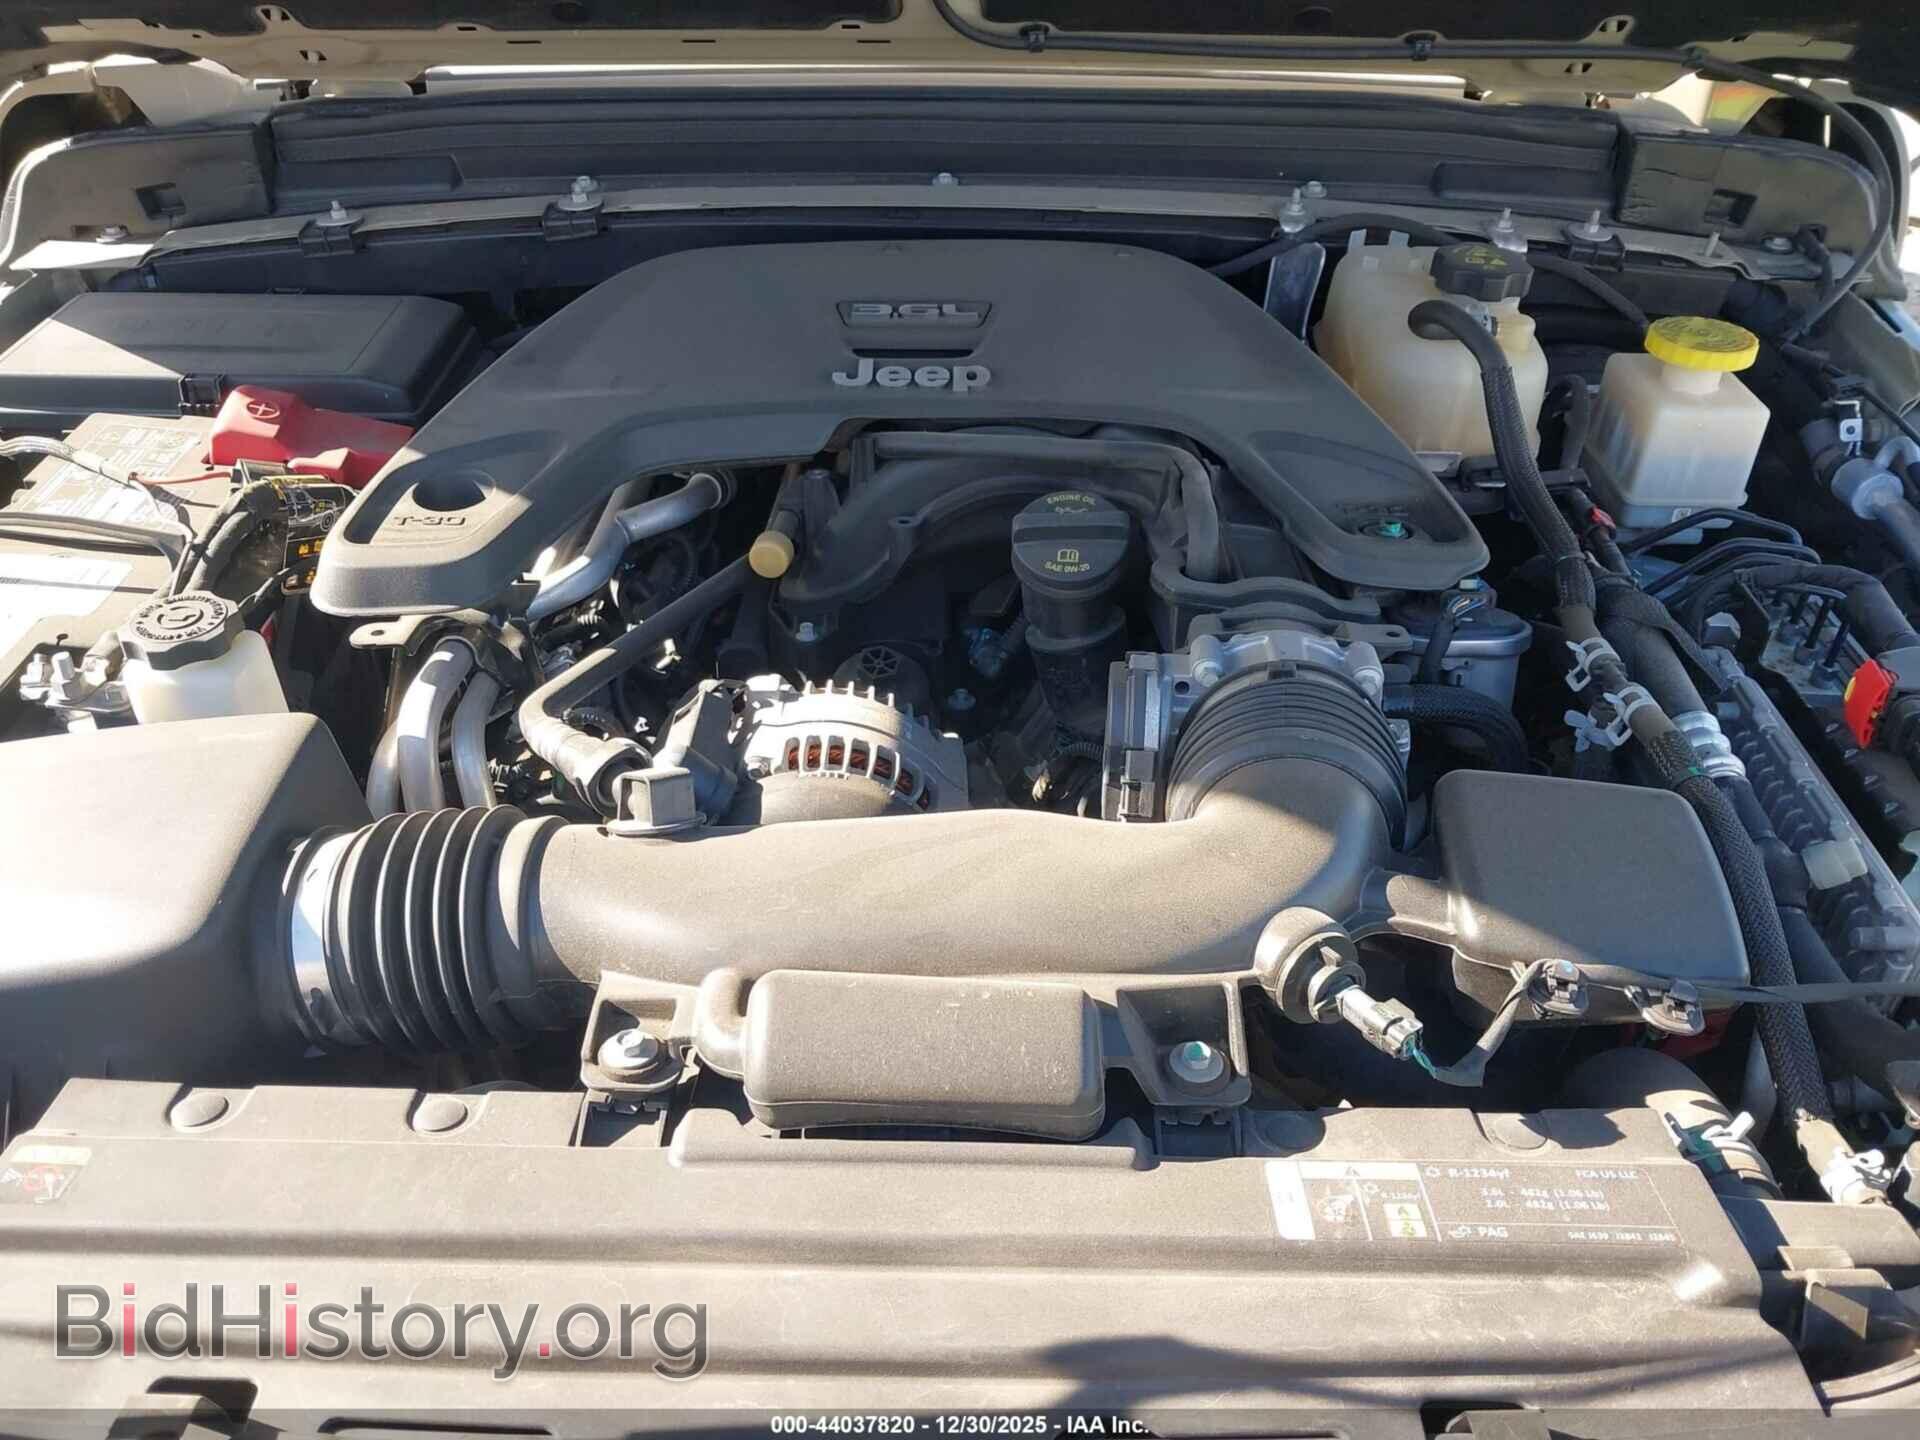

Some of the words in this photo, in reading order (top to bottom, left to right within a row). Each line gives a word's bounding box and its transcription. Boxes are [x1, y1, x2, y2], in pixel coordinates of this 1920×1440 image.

[831, 358, 992, 393] Jeep
[1046, 494, 1081, 504] ENGINE
[1082, 495, 1096, 505] OIL
[393, 515, 467, 527] T-30
[1044, 561, 1064, 573] SAE
[1575, 1169, 1598, 1179] FCA
[1599, 1170, 1616, 1179] US
[1618, 1170, 1640, 1179] LLC
[1477, 1226, 1509, 1239] PAG
